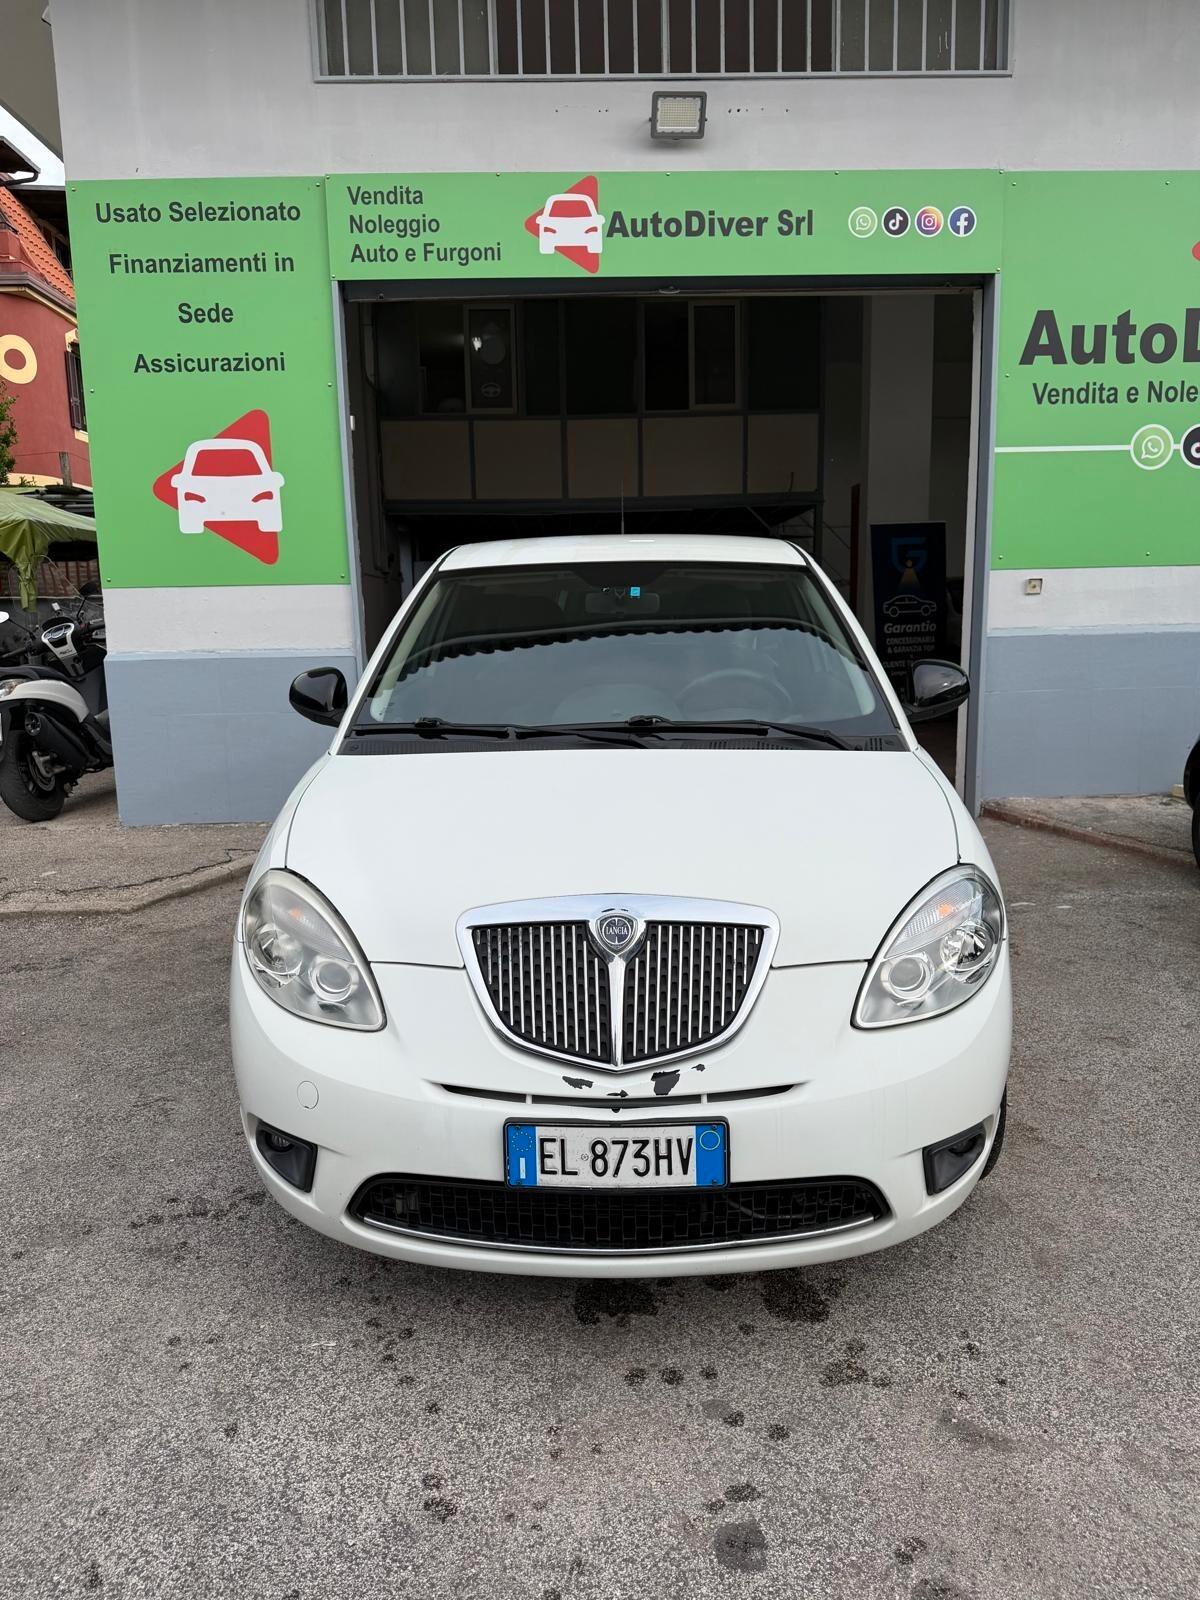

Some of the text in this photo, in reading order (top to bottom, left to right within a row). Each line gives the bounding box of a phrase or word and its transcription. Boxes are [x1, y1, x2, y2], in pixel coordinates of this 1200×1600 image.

[347, 185, 424, 206] Vendita
[95, 200, 301, 224] Usato Selezionato
[606, 209, 814, 238] AutoDiver Srl
[349, 213, 440, 239] Noleggio
[109, 251, 295, 274] Finanziamenti in
[350, 241, 502, 266] Auto e Furgoni
[178, 302, 234, 324] Sede
[133, 350, 286, 374] Assicurazioni
[1032, 381, 1119, 405] Vendita
[1126, 386, 1139, 404] e
[606, 926, 628, 935] LANCIA
[539, 1137, 694, 1178] EL 873HV
